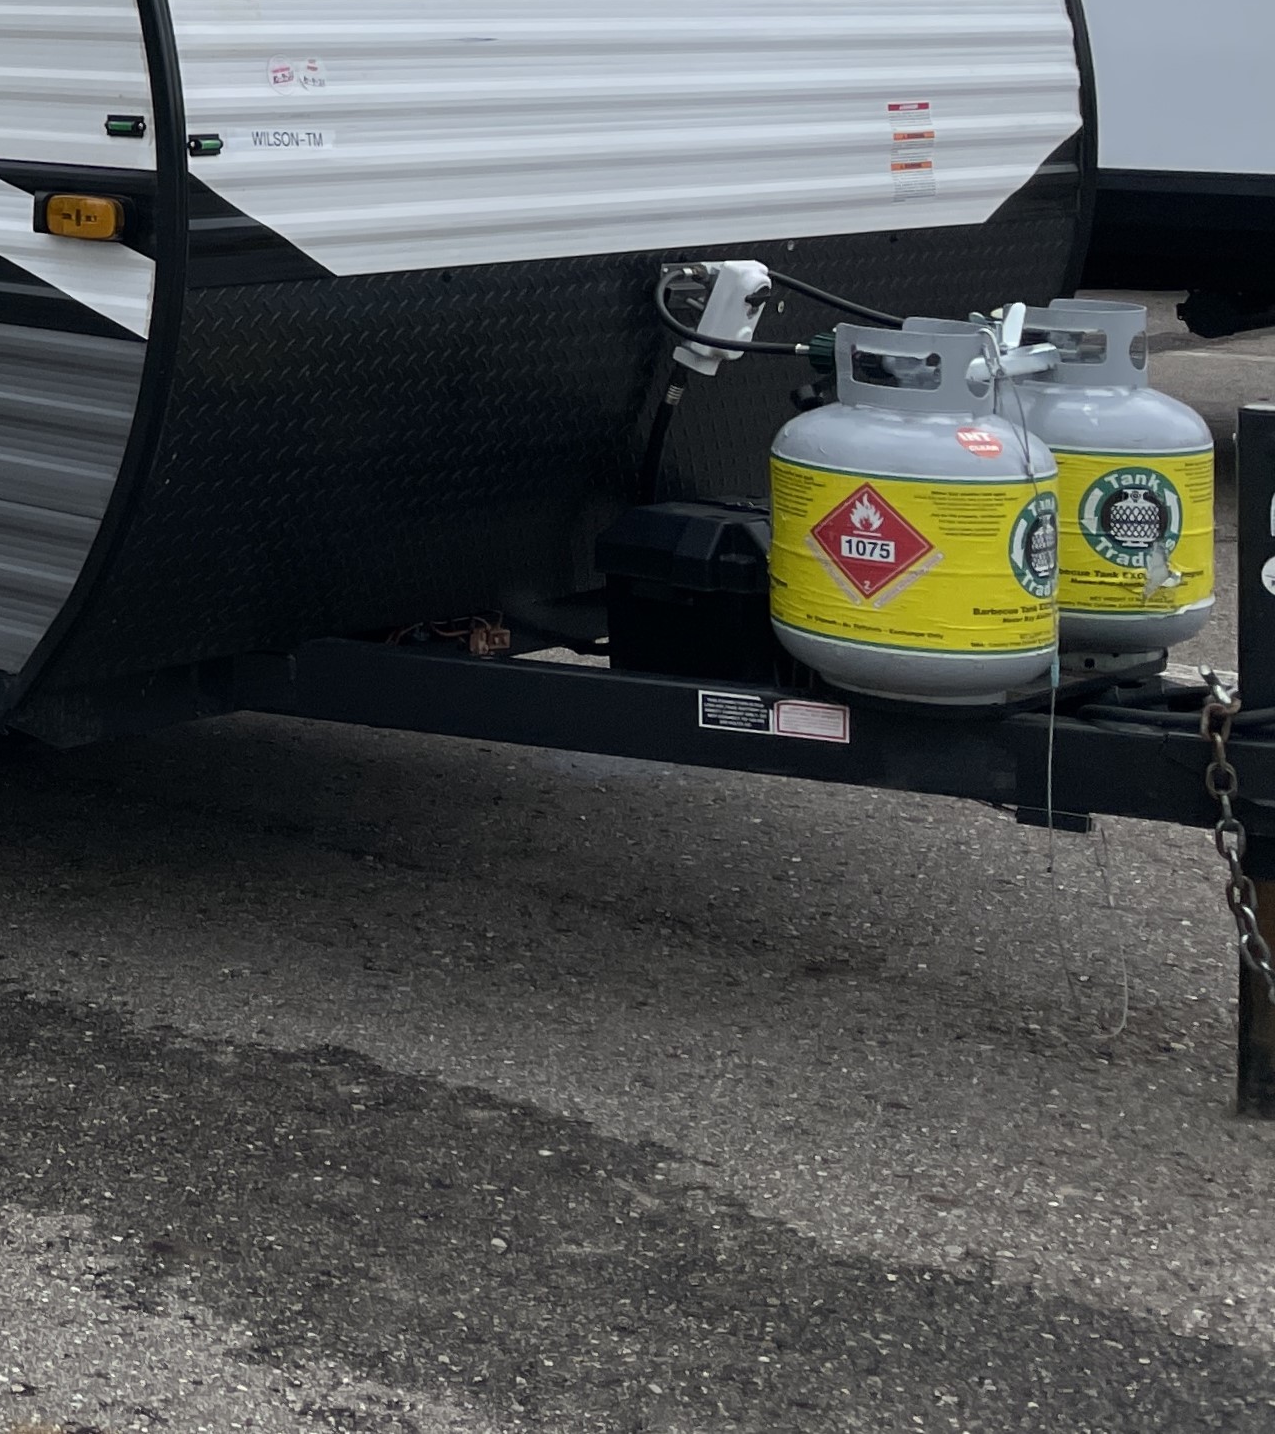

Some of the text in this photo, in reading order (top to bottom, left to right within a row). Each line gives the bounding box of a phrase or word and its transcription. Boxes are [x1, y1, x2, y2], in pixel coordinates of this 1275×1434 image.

[251, 131, 324, 147] WILSON-TM
[1104, 472, 1162, 492] Tank
[844, 538, 890, 559] 1075
[1095, 536, 1176, 567] Trads
[863, 580, 872, 590] 2
[1021, 569, 1051, 597] Trad
